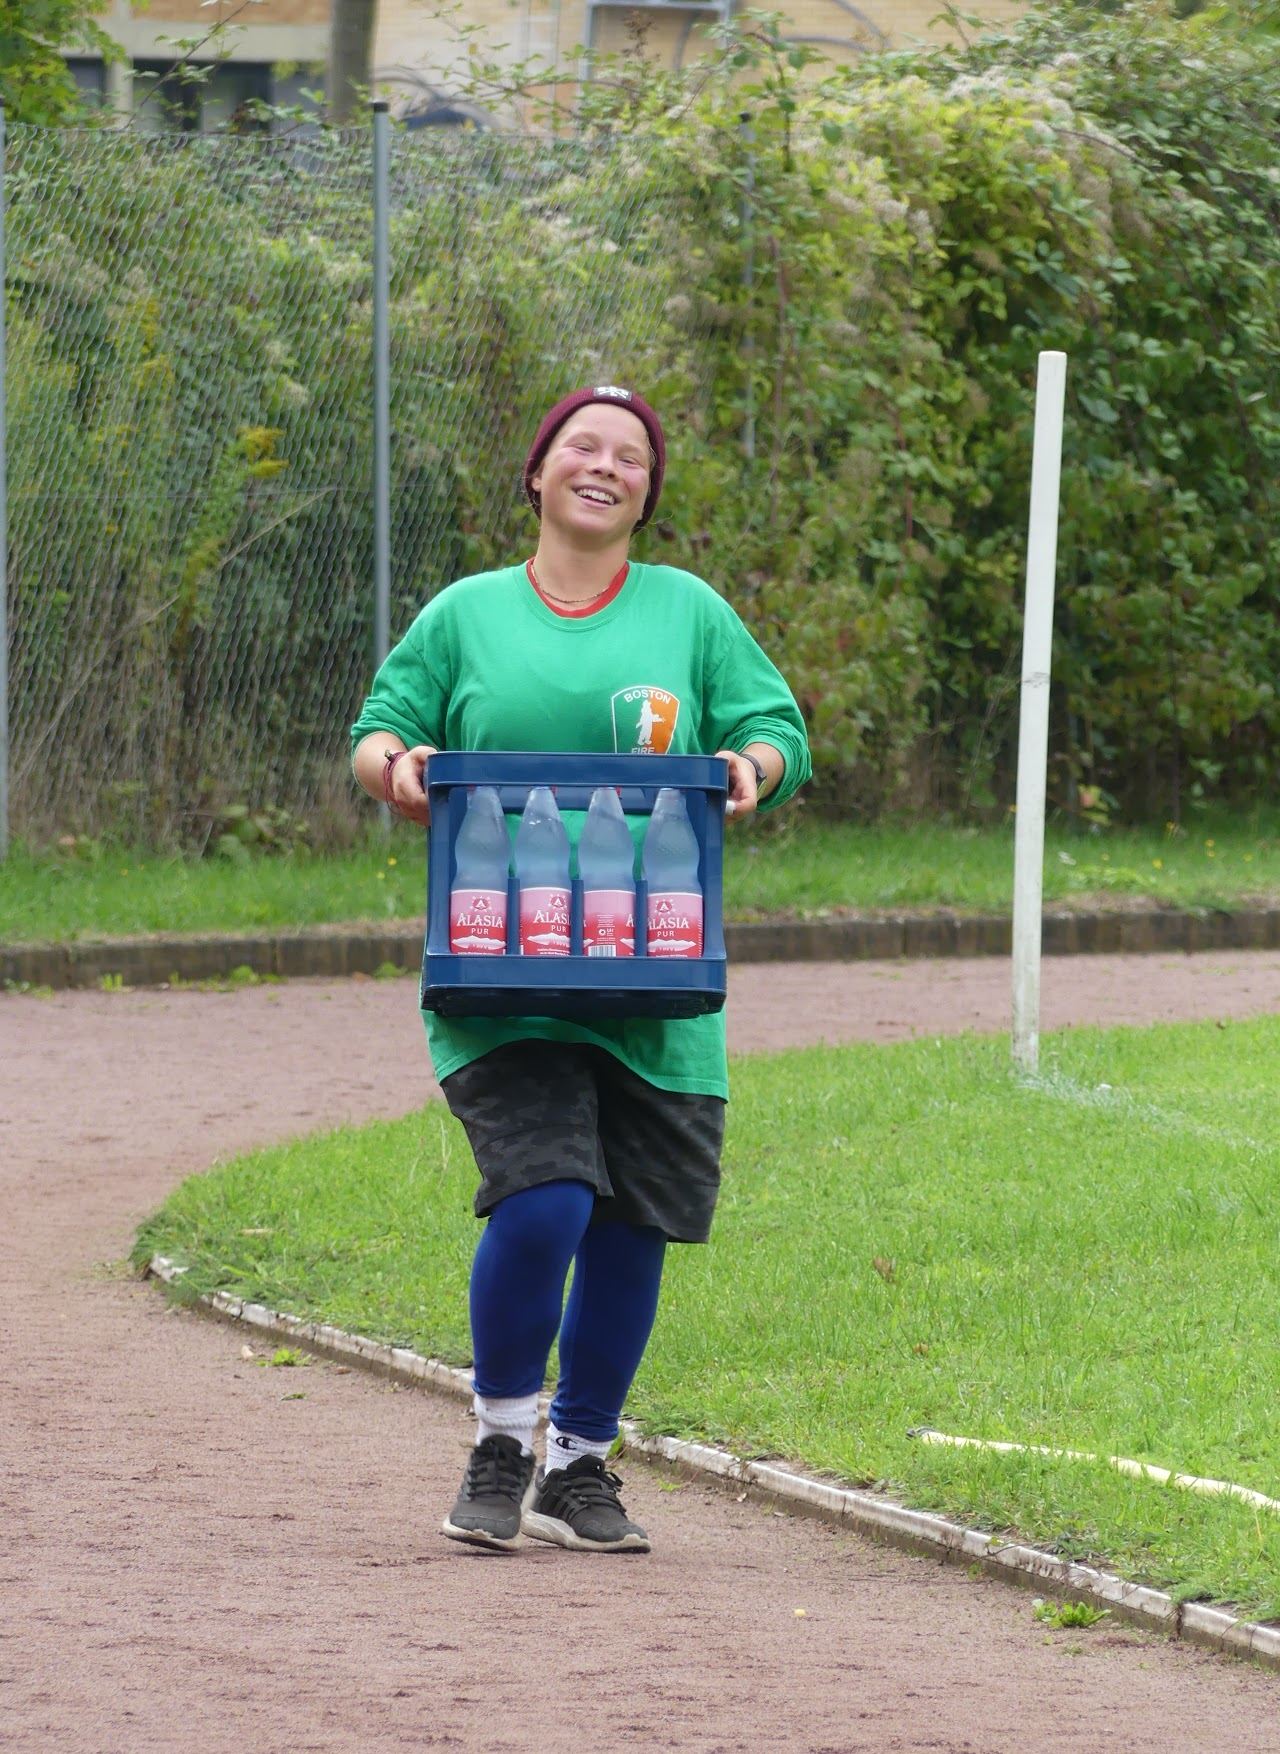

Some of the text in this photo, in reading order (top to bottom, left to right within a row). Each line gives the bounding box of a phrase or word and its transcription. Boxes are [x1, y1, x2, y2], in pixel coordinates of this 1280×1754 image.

[623, 689, 671, 705] BOSTON
[456, 912, 504, 928] ALASIA
[551, 925, 567, 933] PUR
[657, 930, 675, 938] PUR
